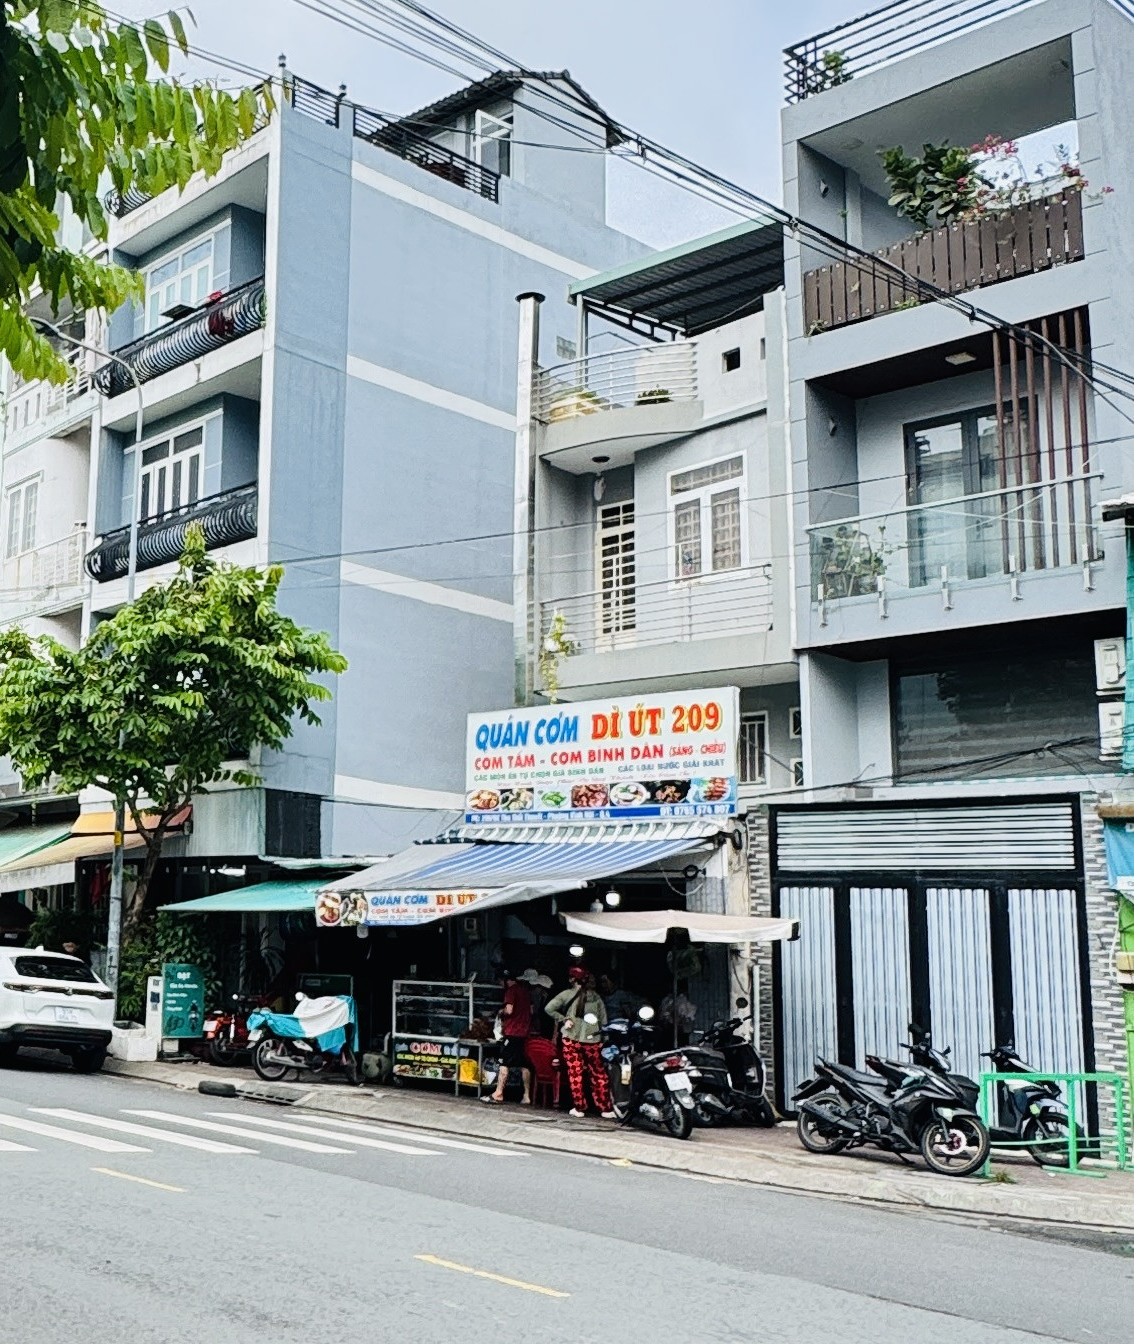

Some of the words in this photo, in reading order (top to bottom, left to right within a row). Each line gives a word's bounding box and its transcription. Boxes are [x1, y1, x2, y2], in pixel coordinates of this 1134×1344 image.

[475, 713, 530, 752] QUÁN
[534, 711, 579, 746] CƠM
[591, 704, 623, 740] DÌ
[671, 701, 723, 734] 209
